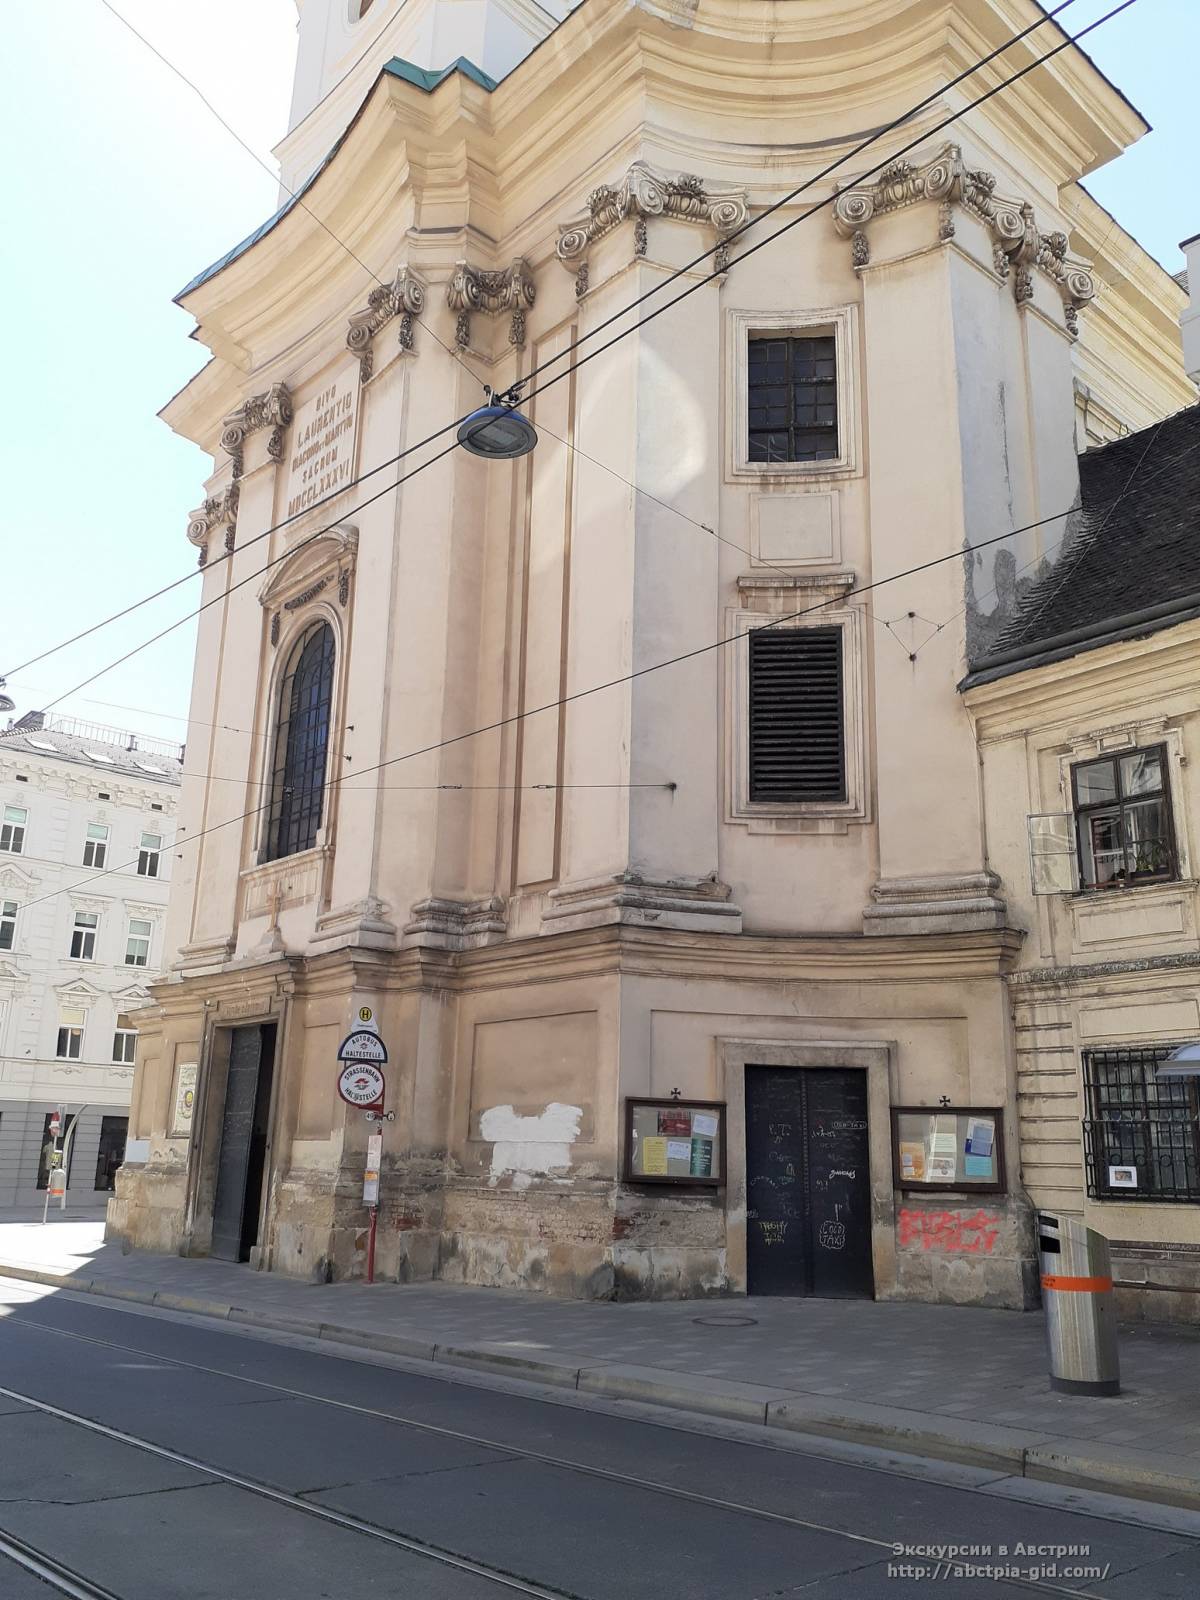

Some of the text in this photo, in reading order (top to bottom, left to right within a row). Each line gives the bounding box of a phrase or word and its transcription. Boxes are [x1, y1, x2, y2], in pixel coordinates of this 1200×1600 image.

[316, 384, 336, 411] DIVO
[297, 391, 352, 448] LAURENTIO
[303, 446, 338, 483] SACRUM
[352, 1035, 377, 1047] AUTOBUS
[345, 1050, 382, 1058] HALTESTELLE
[344, 1067, 381, 1083] STRASSENBAHN
